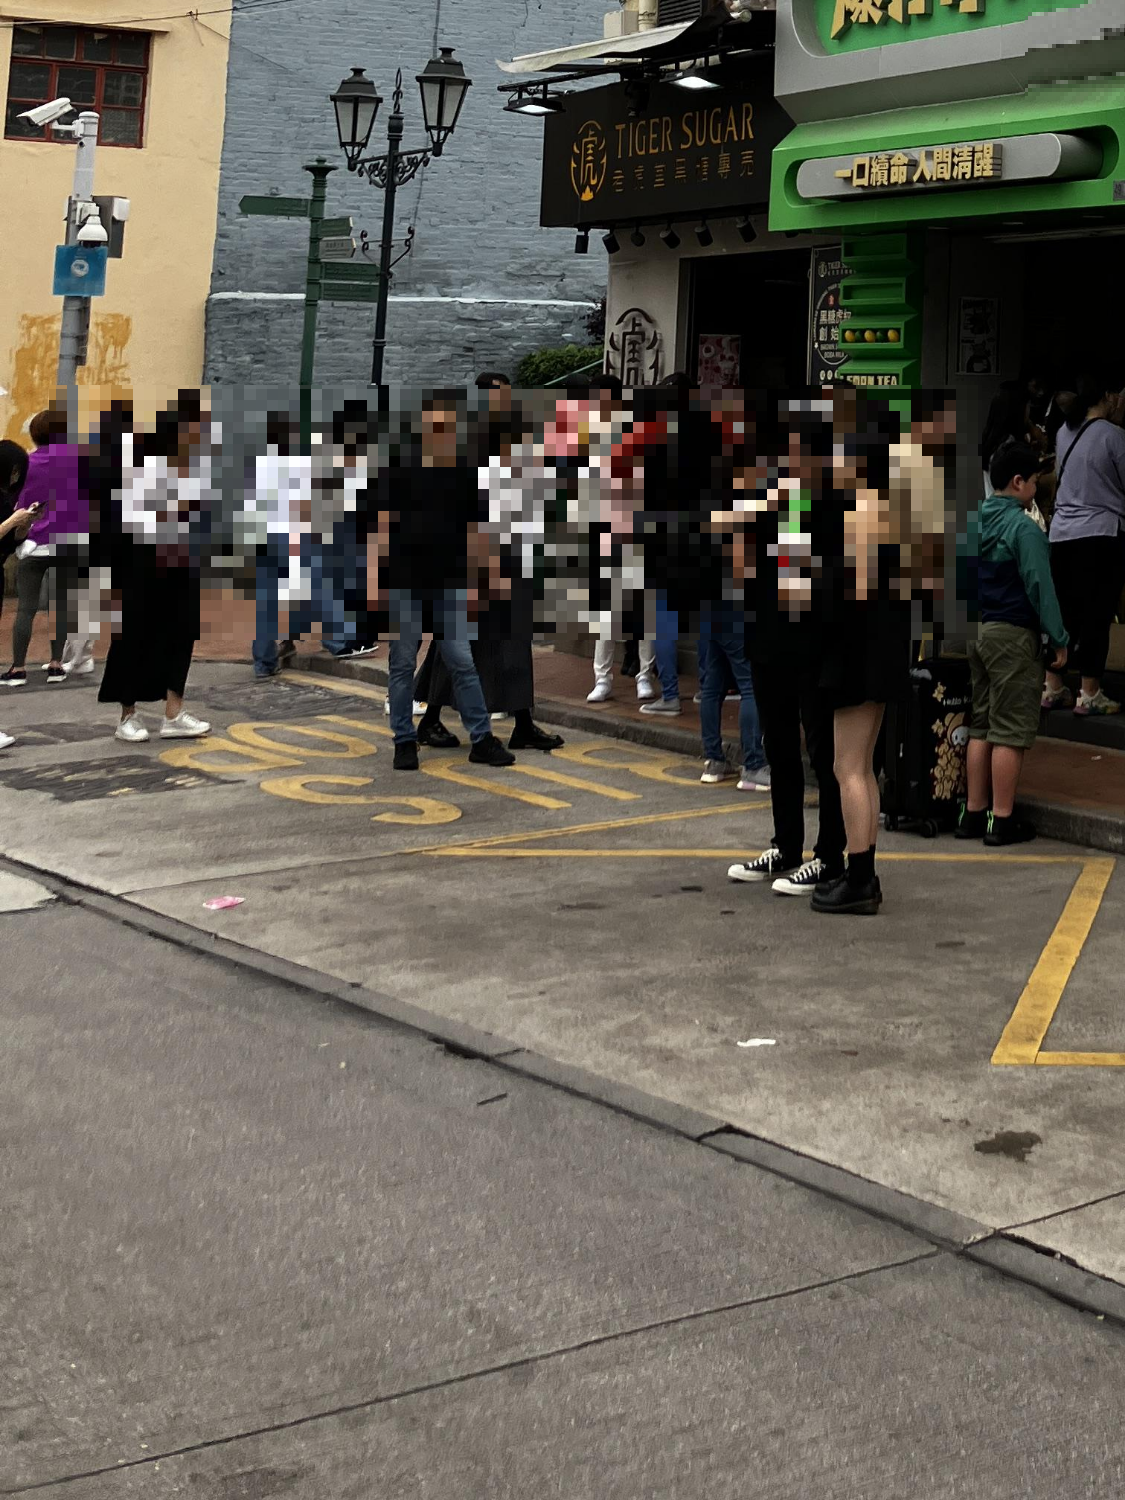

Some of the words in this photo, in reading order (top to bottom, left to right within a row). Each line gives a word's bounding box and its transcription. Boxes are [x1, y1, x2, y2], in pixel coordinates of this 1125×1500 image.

[615, 116, 673, 160] TIGER
[680, 103, 755, 150] SUGAR
[834, 153, 909, 187] 一口續命
[913, 143, 994, 182] 人間清醒
